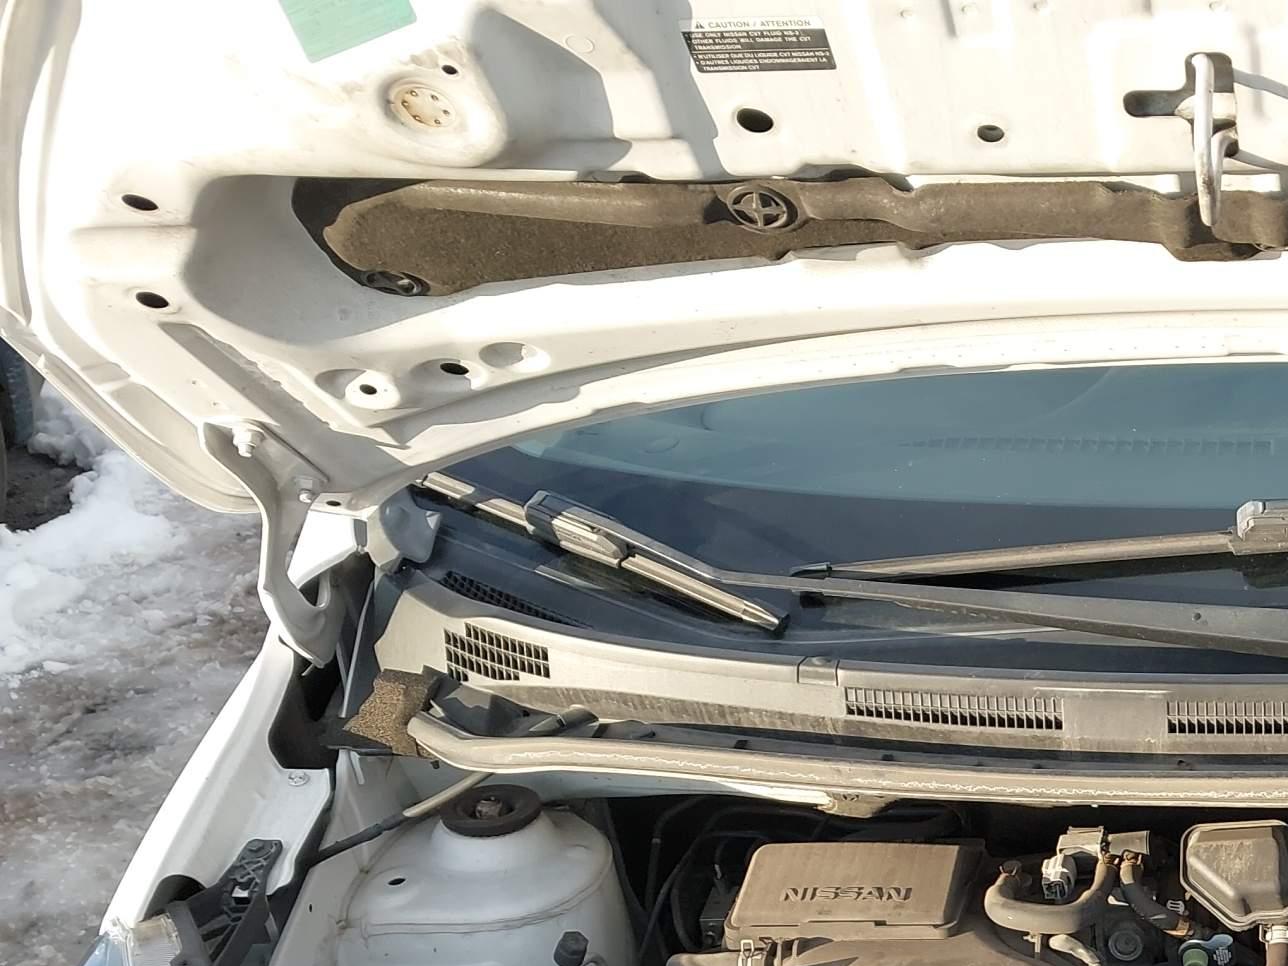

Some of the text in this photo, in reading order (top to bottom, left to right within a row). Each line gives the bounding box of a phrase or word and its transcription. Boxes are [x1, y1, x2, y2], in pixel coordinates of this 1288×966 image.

[708, 21, 750, 29] CAUTION
[760, 19, 811, 27] ATTENTION
[780, 886, 913, 903] NISSAN
